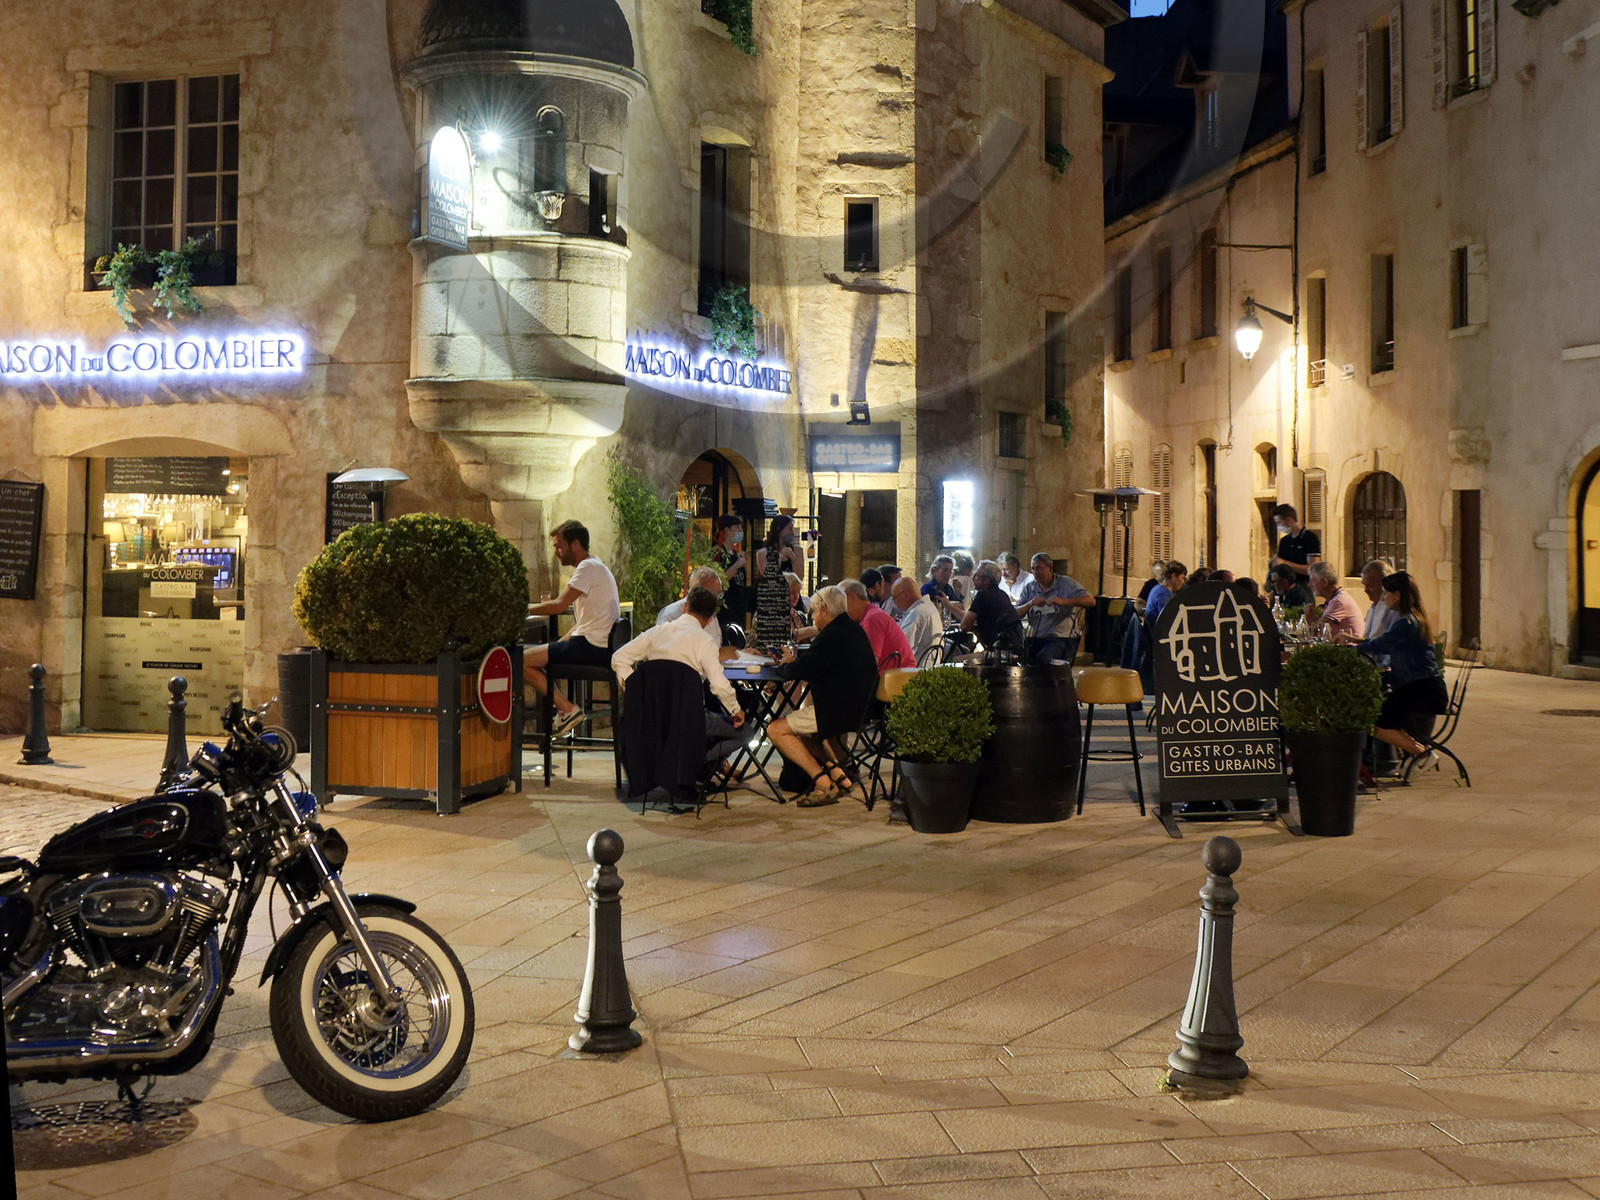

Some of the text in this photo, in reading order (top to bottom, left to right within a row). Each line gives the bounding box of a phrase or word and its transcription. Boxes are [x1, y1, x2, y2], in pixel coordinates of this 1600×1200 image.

[431, 178, 468, 206] MAISON
[80, 357, 104, 373] DU
[106, 338, 297, 373] COLOMBIER
[705, 357, 793, 395] COLOMBIER
[151, 569, 204, 580] COLOMBIER
[1161, 689, 1279, 715] MAISON
[1161, 717, 1279, 735] DU COLOMBIER
[1170, 758, 1276, 772] GITES URBAINS
